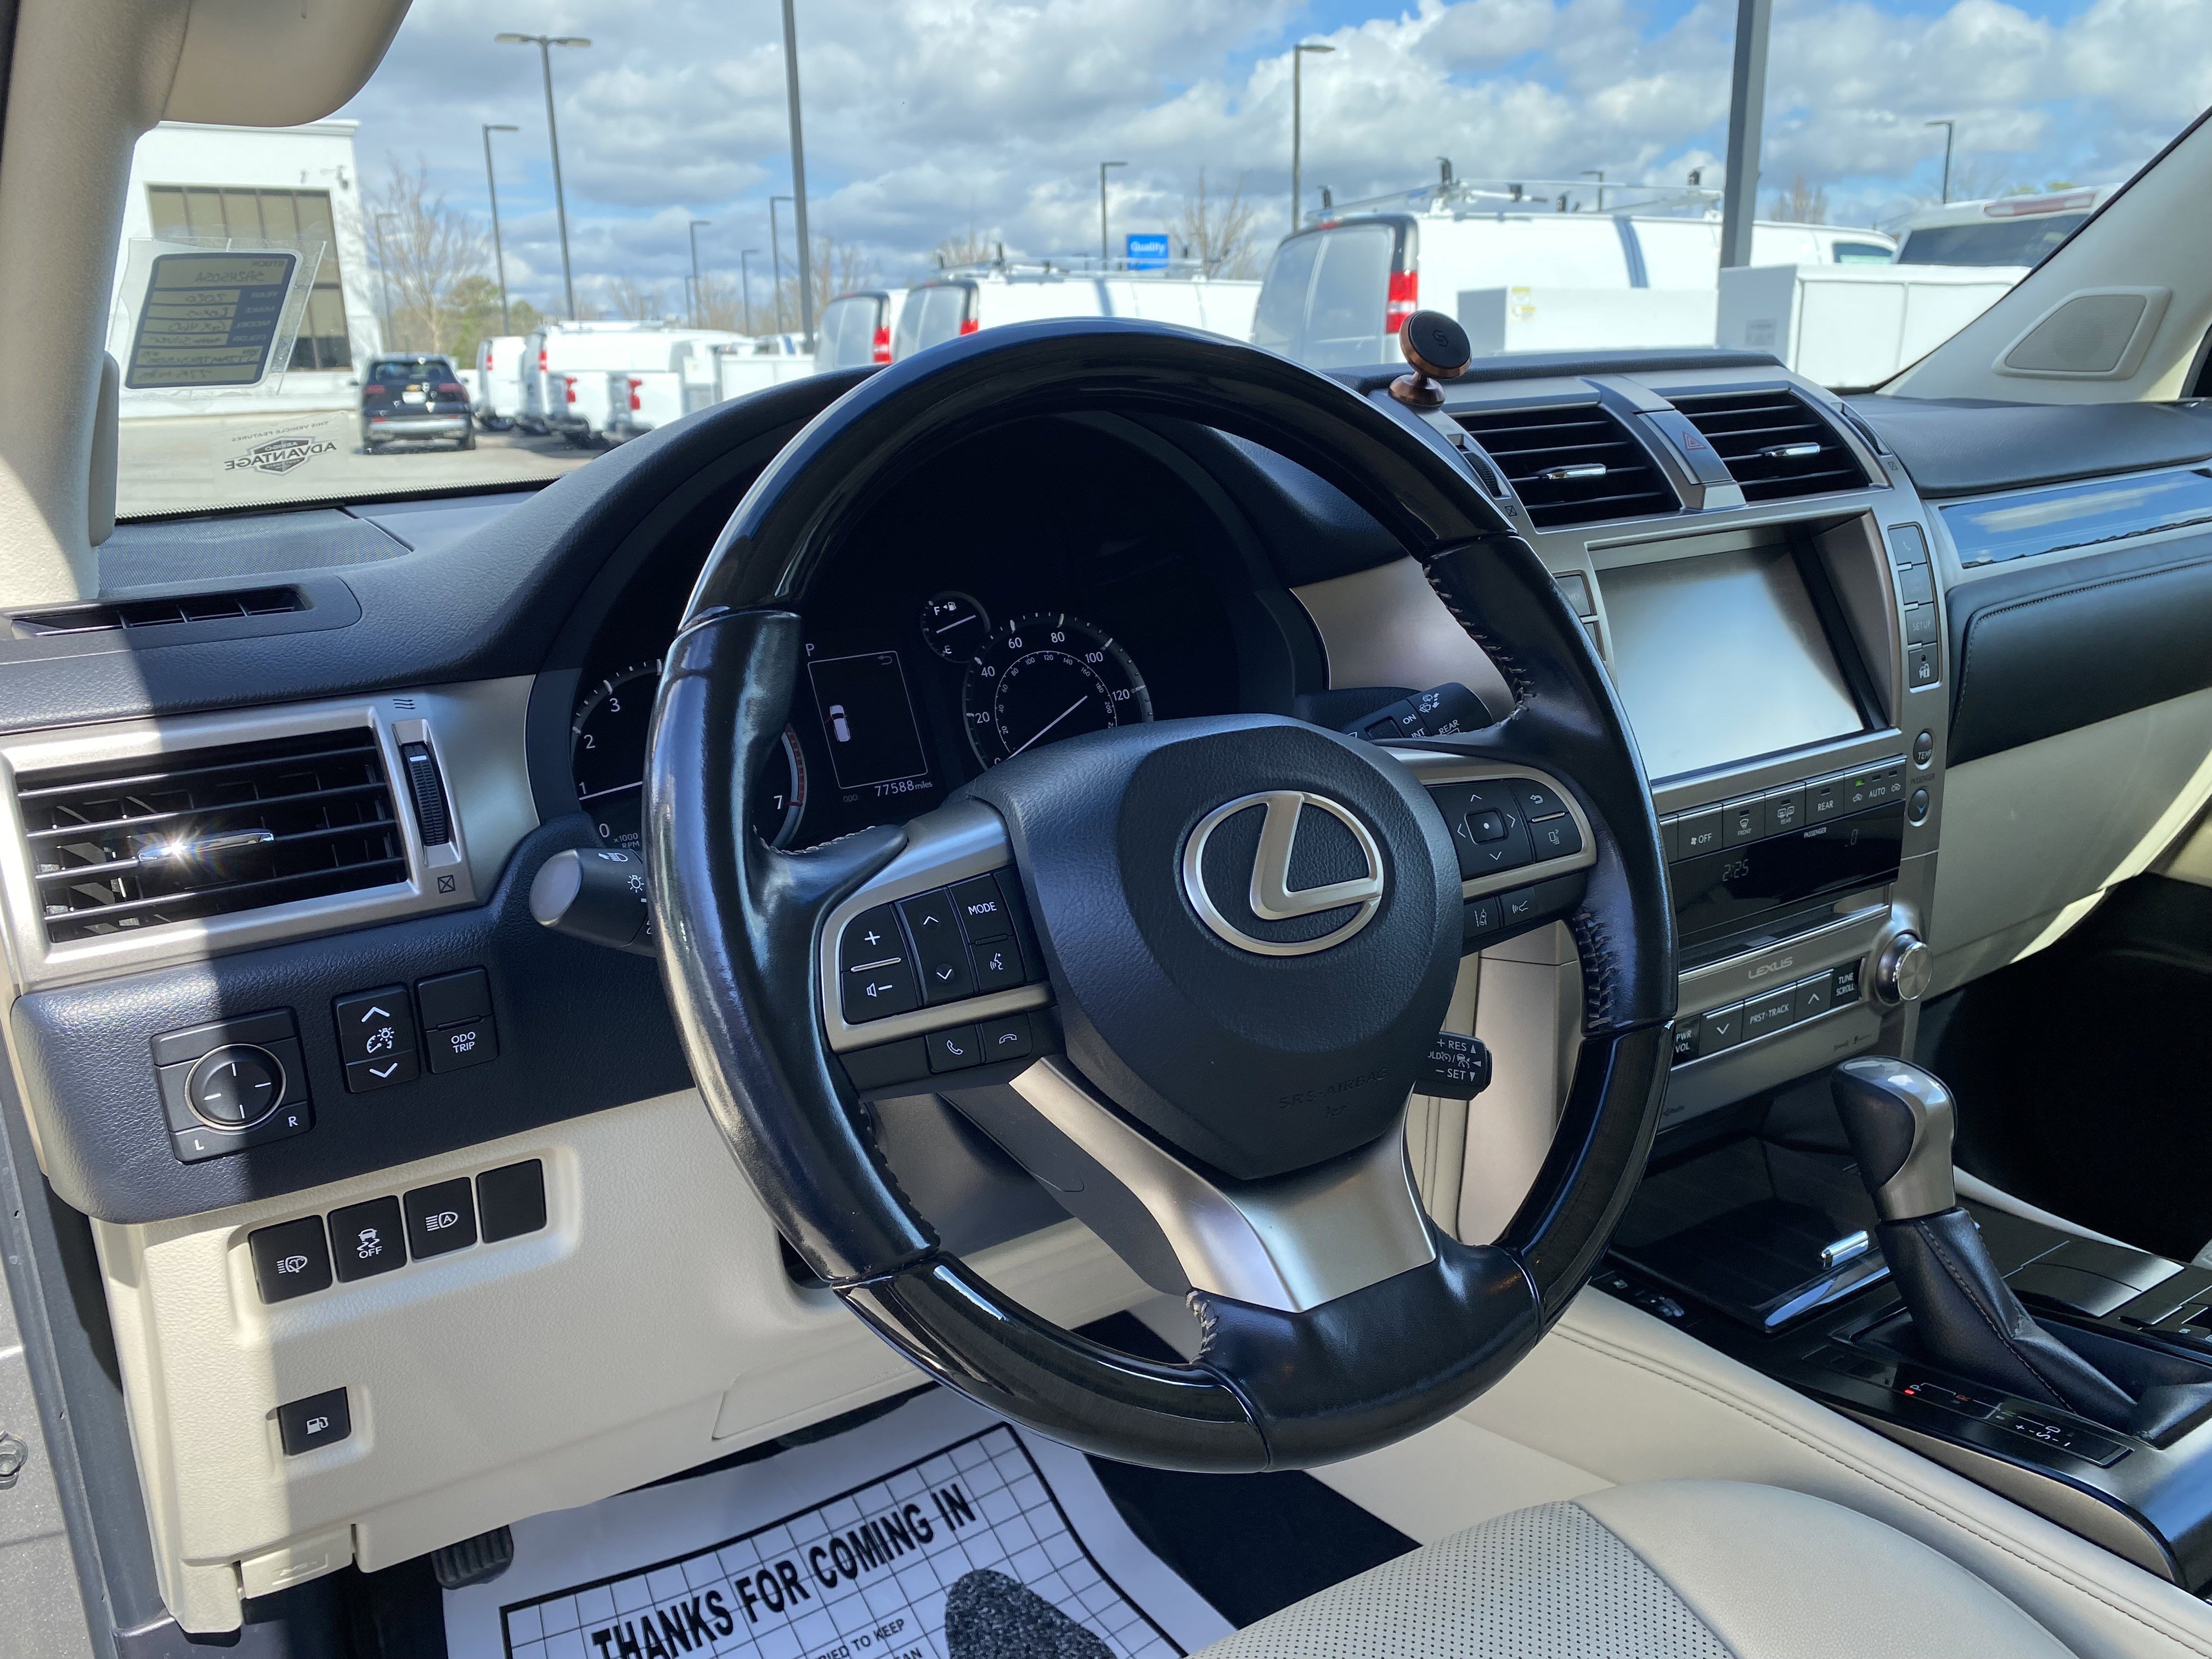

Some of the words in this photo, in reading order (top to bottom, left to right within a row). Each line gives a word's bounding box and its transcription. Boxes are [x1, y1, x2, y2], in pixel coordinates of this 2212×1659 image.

[1912, 620, 1931, 631] SETUP
[1008, 636, 1023, 649] 60
[1051, 631, 1065, 644] 80
[805, 643, 815, 657] P
[1025, 657, 1036, 665] 100
[1063, 657, 1073, 665] 140
[1085, 651, 1104, 664] 100
[980, 665, 996, 679] 40
[1011, 667, 1019, 677] 80
[1080, 667, 1091, 678] 160
[1001, 684, 1008, 693] 60
[1111, 689, 1130, 702] 120
[609, 697, 620, 713] 3
[975, 712, 990, 724] 20
[1403, 713, 1417, 724] ON
[1411, 727, 1425, 738] INT
[1438, 719, 1459, 736] REAR
[583, 734, 595, 749] 2
[579, 782, 586, 795] 1
[874, 780, 914, 797] 77588
[915, 781, 933, 790] miles
[1869, 787, 1886, 798] AUTO
[774, 795, 783, 809] 7
[1818, 800, 1833, 812] REAR
[599, 823, 610, 838] 0
[1737, 828, 1752, 837] FRONT
[1803, 827, 1827, 839] PASSENGER
[622, 840, 640, 849] RPM
[1698, 833, 1712, 844] OFF
[1722, 859, 1749, 882] 2:25
[968, 901, 997, 916] MODE
[1748, 956, 1793, 980] LEXUS
[1838, 972, 1854, 985] TUNE
[1836, 983, 1855, 996] SCROLL
[450, 1031, 476, 1043] ODO
[1676, 1030, 1691, 1042] PWR
[453, 1040, 476, 1053] TRIP
[1448, 1040, 1467, 1052] RES
[1675, 1042, 1690, 1053] VOL
[1447, 1068, 1466, 1080] SET
[288, 1115, 298, 1127] R
[195, 1139, 204, 1152] L
[358, 1245, 382, 1259] OFF
[591, 1589, 734, 1659] THANKS
[734, 1558, 811, 1624] FOR
[808, 1502, 934, 1589] COMING
[930, 1482, 977, 1531] IN
[850, 1635, 871, 1651] TO
[873, 1618, 905, 1641] KEEP
